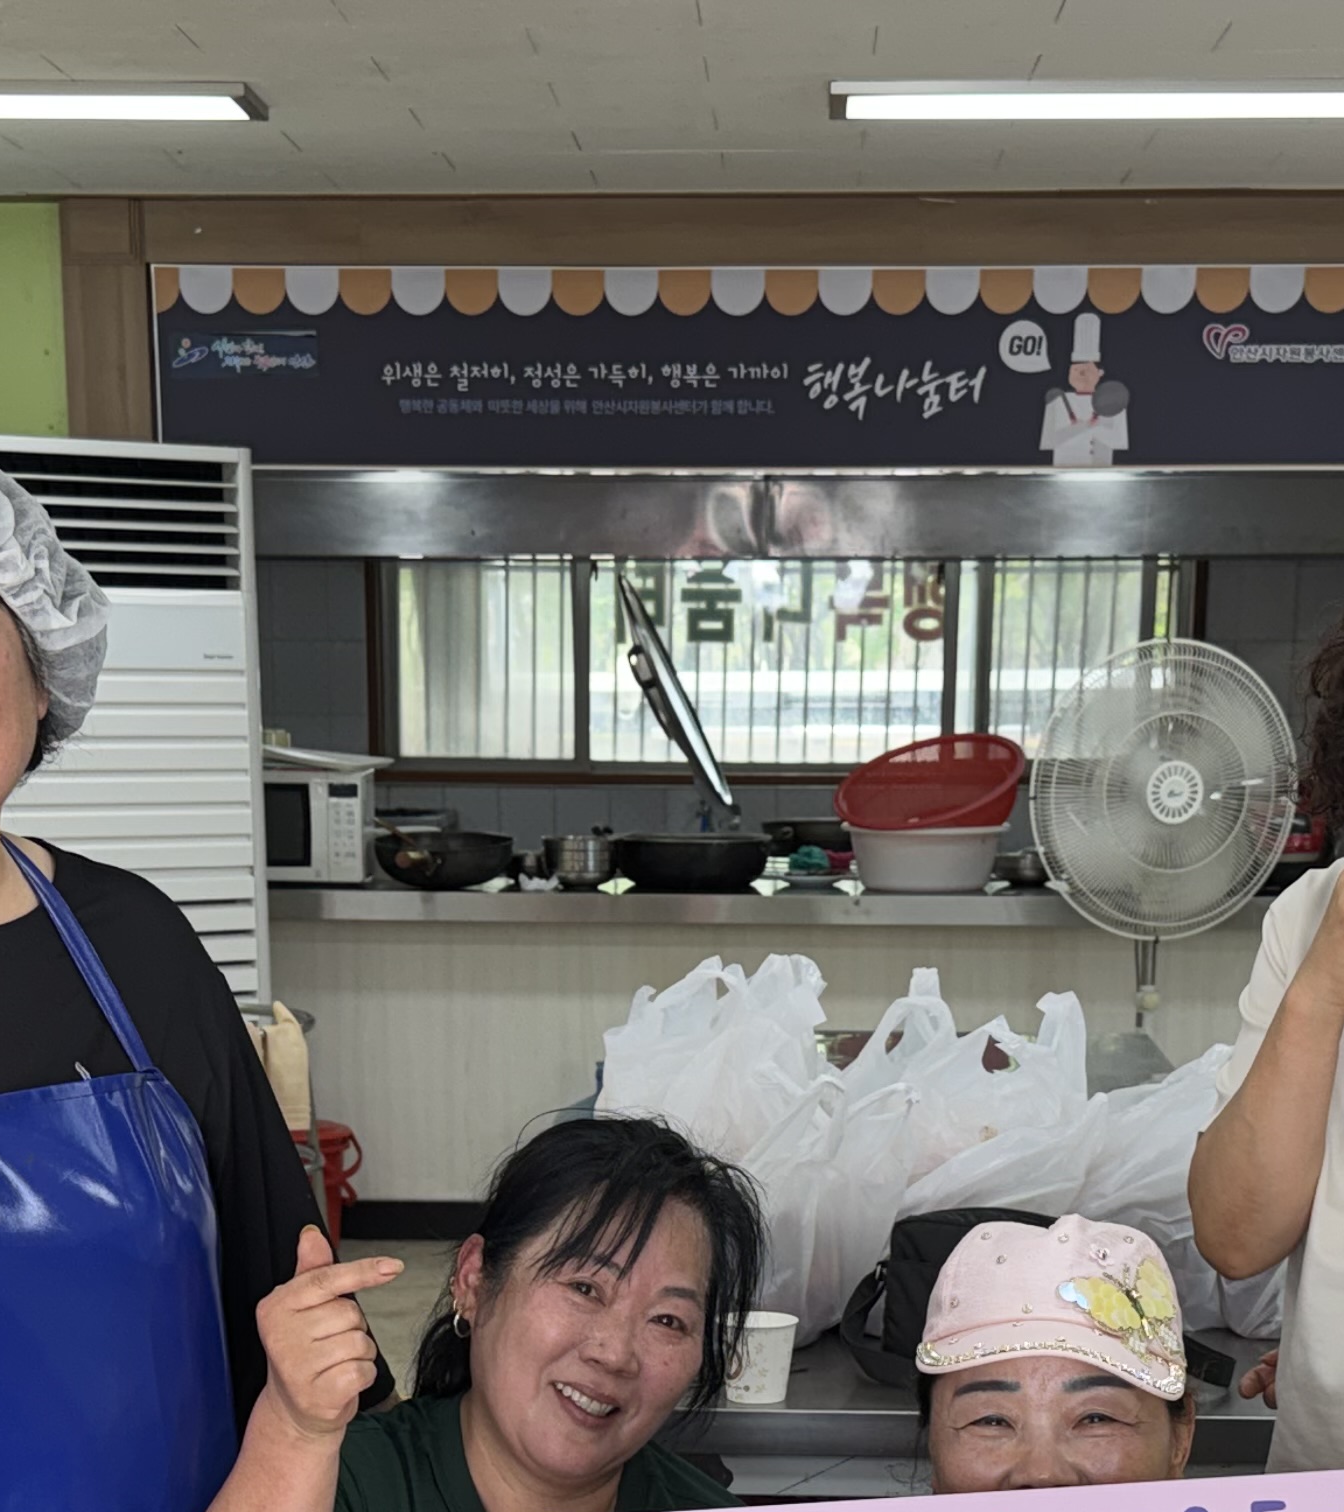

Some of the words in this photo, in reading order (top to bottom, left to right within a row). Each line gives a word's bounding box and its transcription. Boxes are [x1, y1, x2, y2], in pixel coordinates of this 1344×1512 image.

[1007, 335, 1043, 358] GO!
[381, 361, 443, 388] 위생은
[449, 361, 516, 392] 철저히,
[523, 362, 582, 389] 정성은
[588, 362, 654, 388] 가득히,
[660, 362, 721, 388] 행복은
[727, 362, 789, 380] 가까이
[802, 355, 987, 421] 행복나눔터
